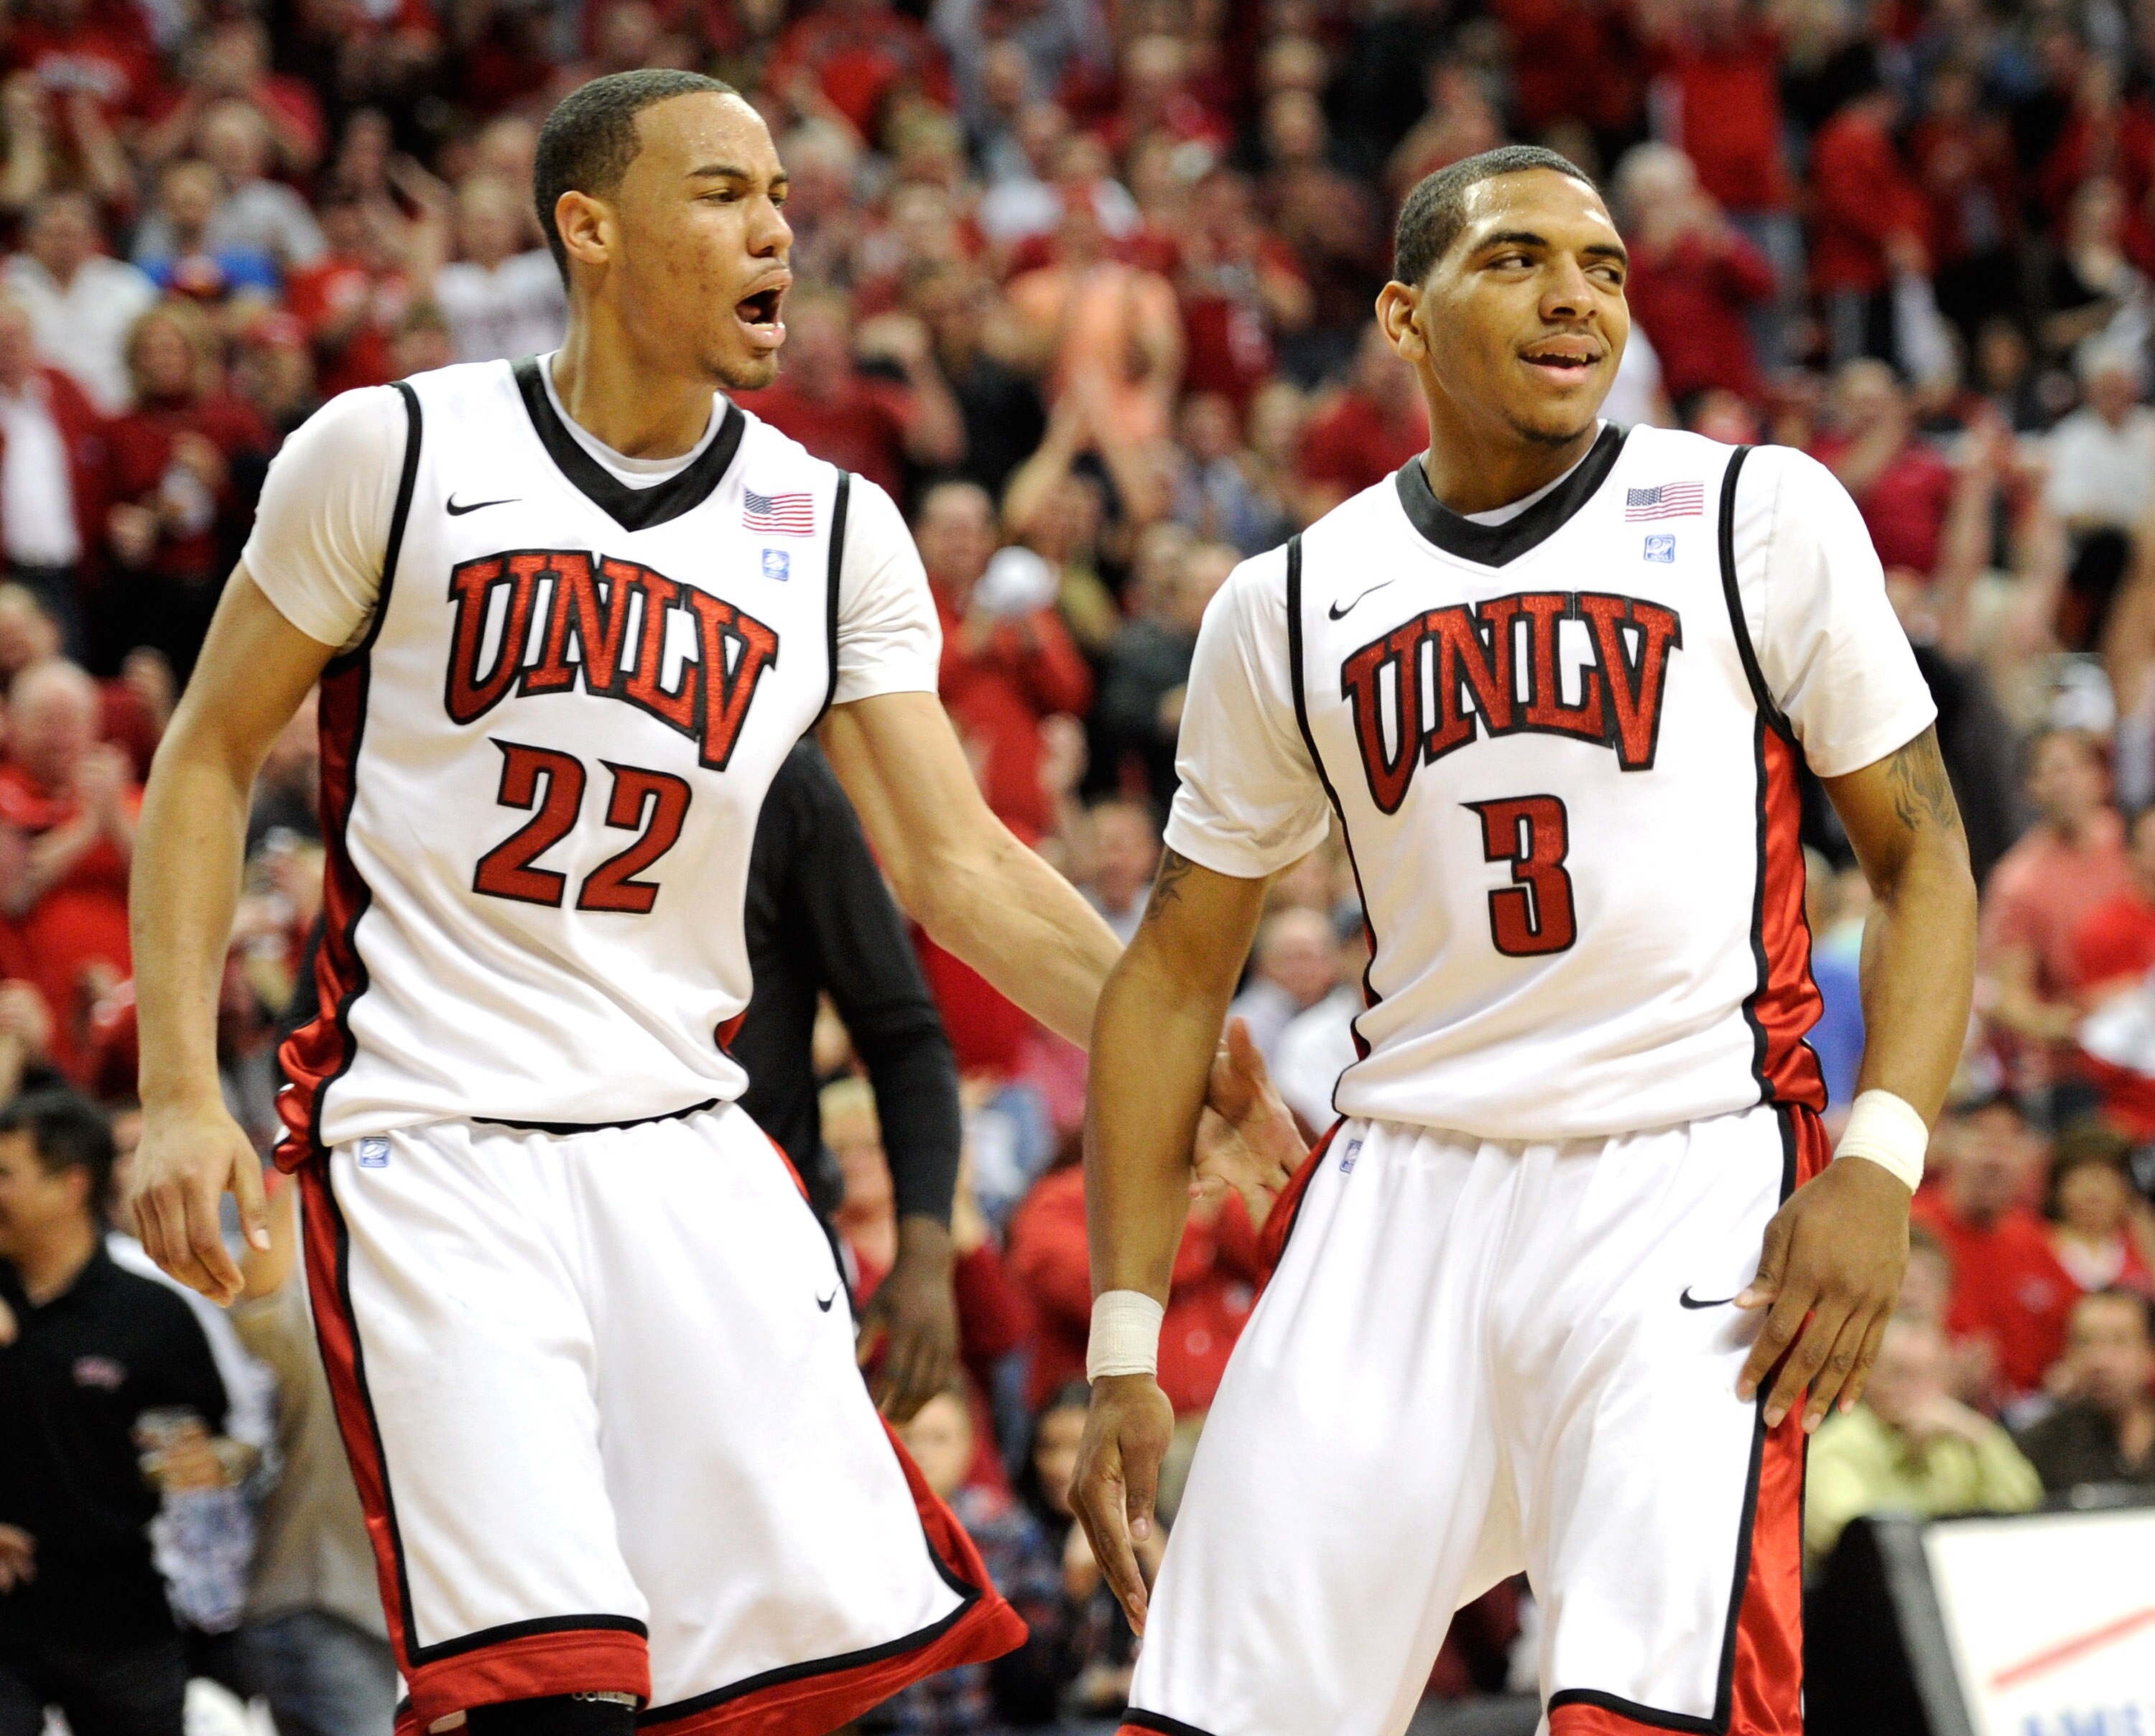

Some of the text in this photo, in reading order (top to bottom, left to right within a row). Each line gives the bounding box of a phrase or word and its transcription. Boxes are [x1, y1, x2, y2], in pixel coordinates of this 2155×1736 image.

[444, 548, 779, 772] UNLV
[1340, 590, 1683, 815] UNLV
[472, 737, 692, 914] 22
[1458, 794, 1577, 957] 3
